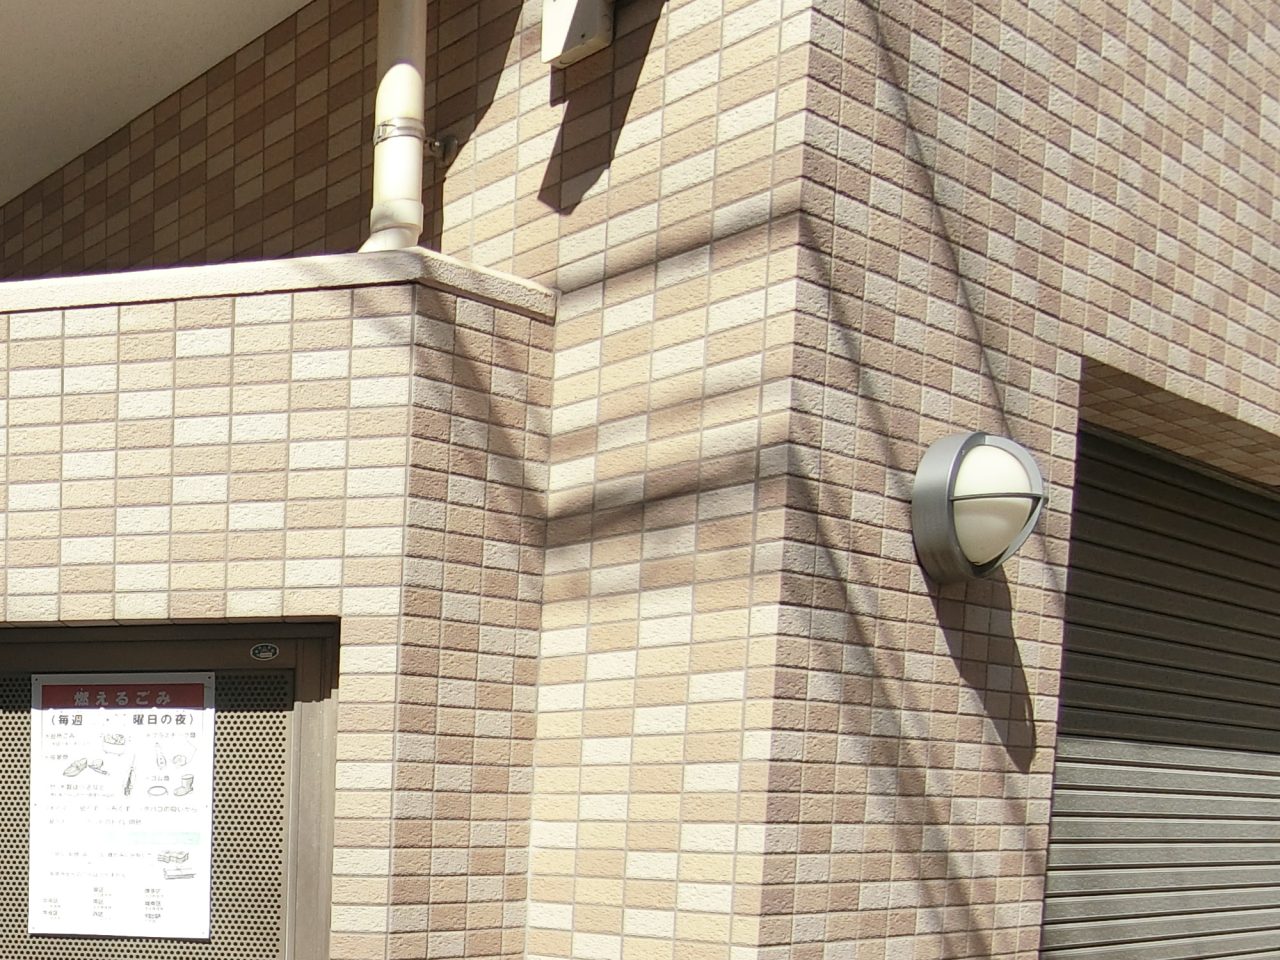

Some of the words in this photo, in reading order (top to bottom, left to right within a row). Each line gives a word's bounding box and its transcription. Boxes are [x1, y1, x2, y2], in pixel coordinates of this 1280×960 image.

[73, 690, 171, 706] 燃えるごみ
